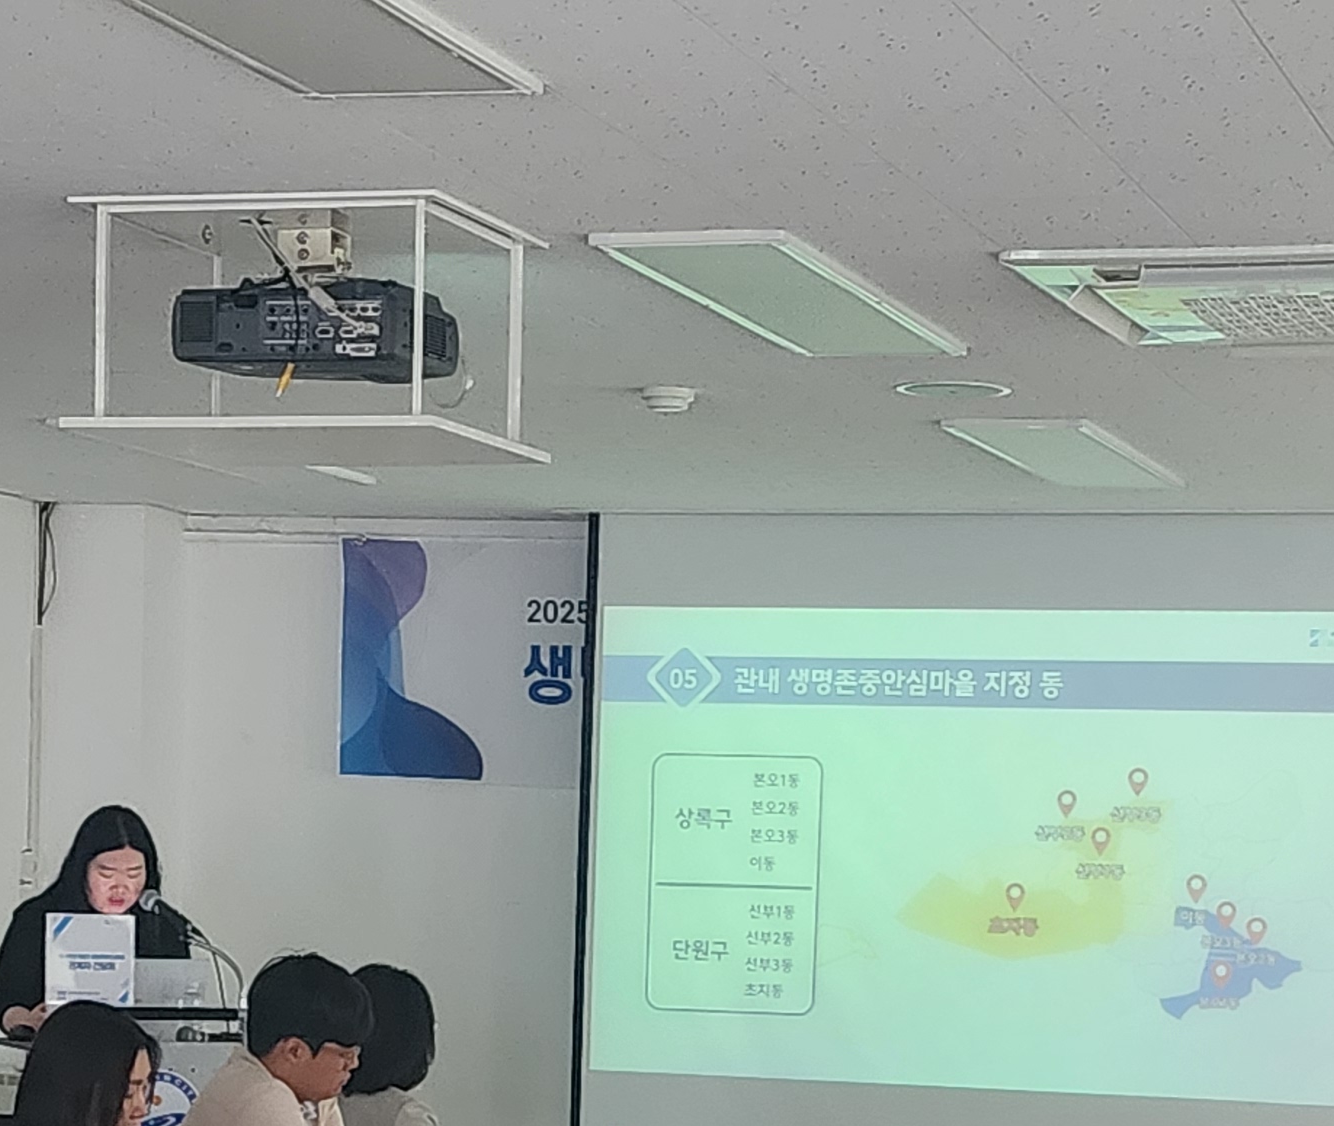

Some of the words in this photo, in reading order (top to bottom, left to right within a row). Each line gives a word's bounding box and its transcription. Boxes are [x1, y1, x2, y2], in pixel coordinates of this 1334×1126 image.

[523, 644, 586, 706] 생
[669, 668, 698, 690] 05
[733, 666, 781, 695] 관내
[786, 666, 977, 698] 생명존중안심마을
[983, 670, 1031, 698] 지정
[1038, 671, 1065, 699] 동
[753, 772, 801, 789] 본오1동
[751, 800, 800, 817] 본오2동
[675, 807, 733, 830] 상록구
[750, 828, 799, 845] 본오3동
[749, 855, 776, 872] 이동
[748, 904, 795, 920] 선부1동
[745, 930, 795, 947] 선부2동
[672, 939, 730, 962] 단원구
[745, 957, 794, 974] 선부3동
[743, 983, 784, 999] 초지동
